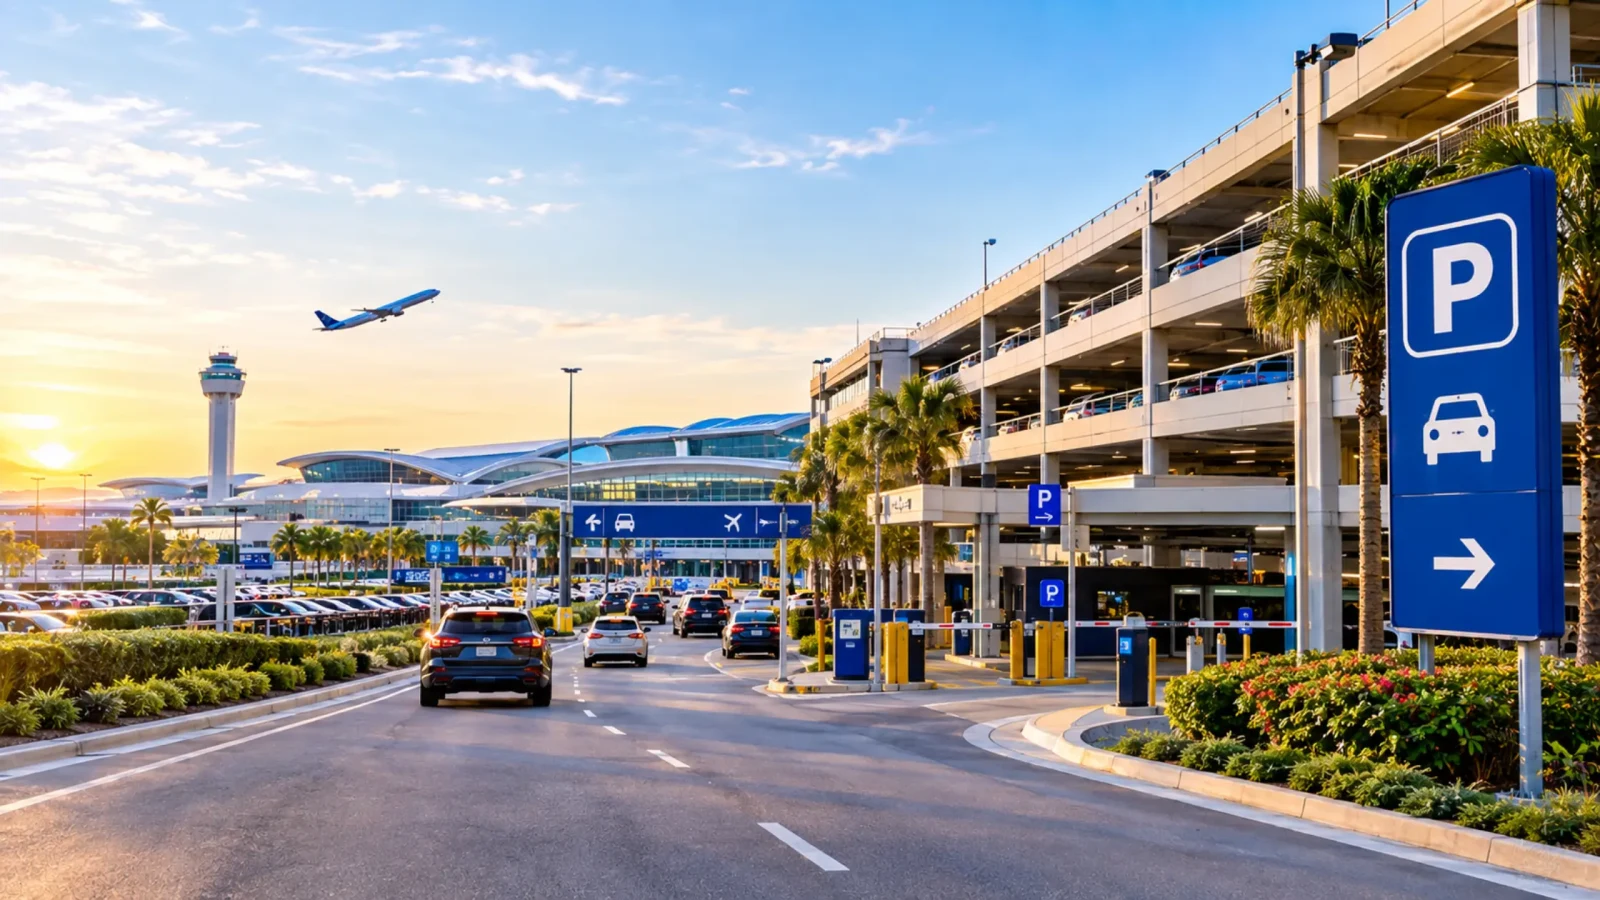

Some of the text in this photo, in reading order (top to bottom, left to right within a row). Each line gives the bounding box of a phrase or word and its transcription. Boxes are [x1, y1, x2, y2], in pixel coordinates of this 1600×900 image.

[1433, 242, 1494, 334] P
[1038, 489, 1052, 509] P
[1046, 584, 1059, 602] P
